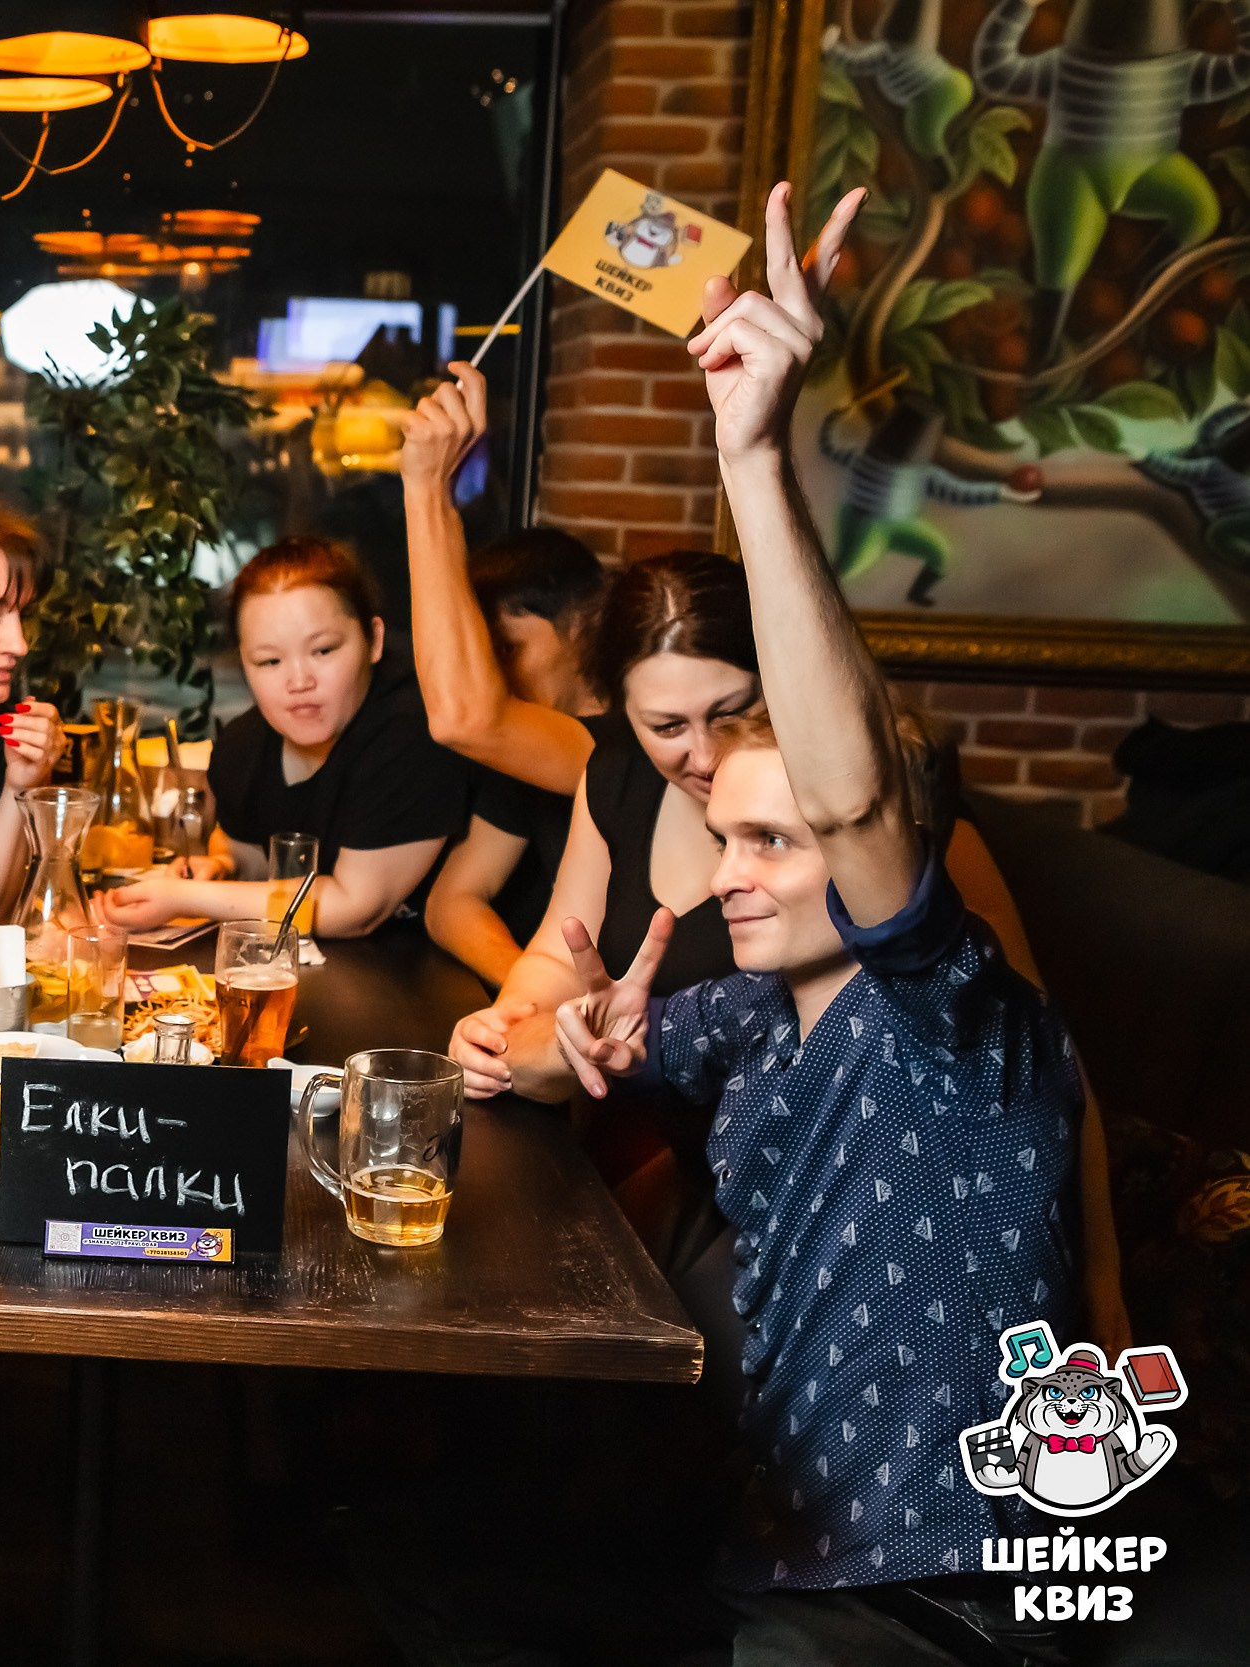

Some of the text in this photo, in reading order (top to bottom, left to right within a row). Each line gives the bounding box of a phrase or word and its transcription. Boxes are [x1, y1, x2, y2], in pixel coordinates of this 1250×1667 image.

[21, 1081, 188, 1143] Елки-
[66, 1157, 245, 1217] палки
[93, 1227, 187, 1242] ШЕЙКЕР КВИЗ
